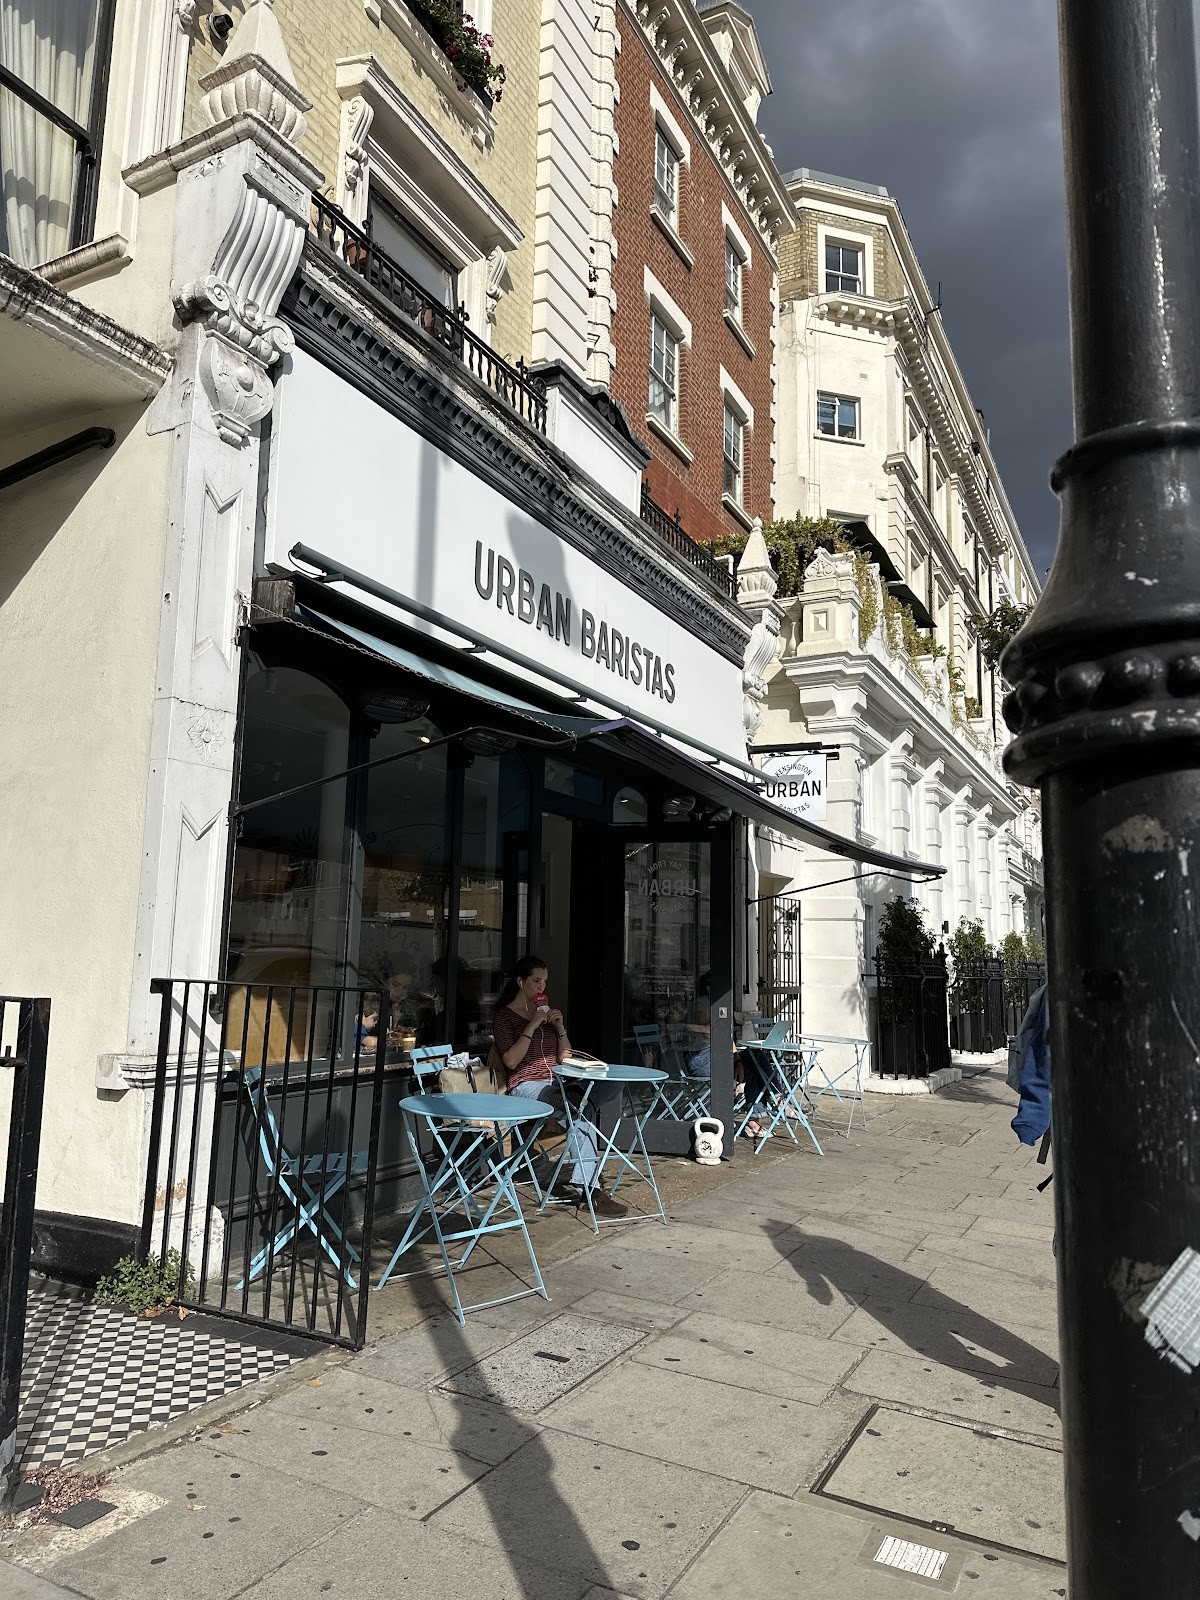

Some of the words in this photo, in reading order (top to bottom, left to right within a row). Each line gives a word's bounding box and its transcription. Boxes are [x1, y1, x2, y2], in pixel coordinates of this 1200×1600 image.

[474, 540, 572, 647] URBAN
[581, 608, 676, 704] BARISTAS
[774, 764, 812, 777] KENSINGTON
[767, 780, 821, 798] URBAN
